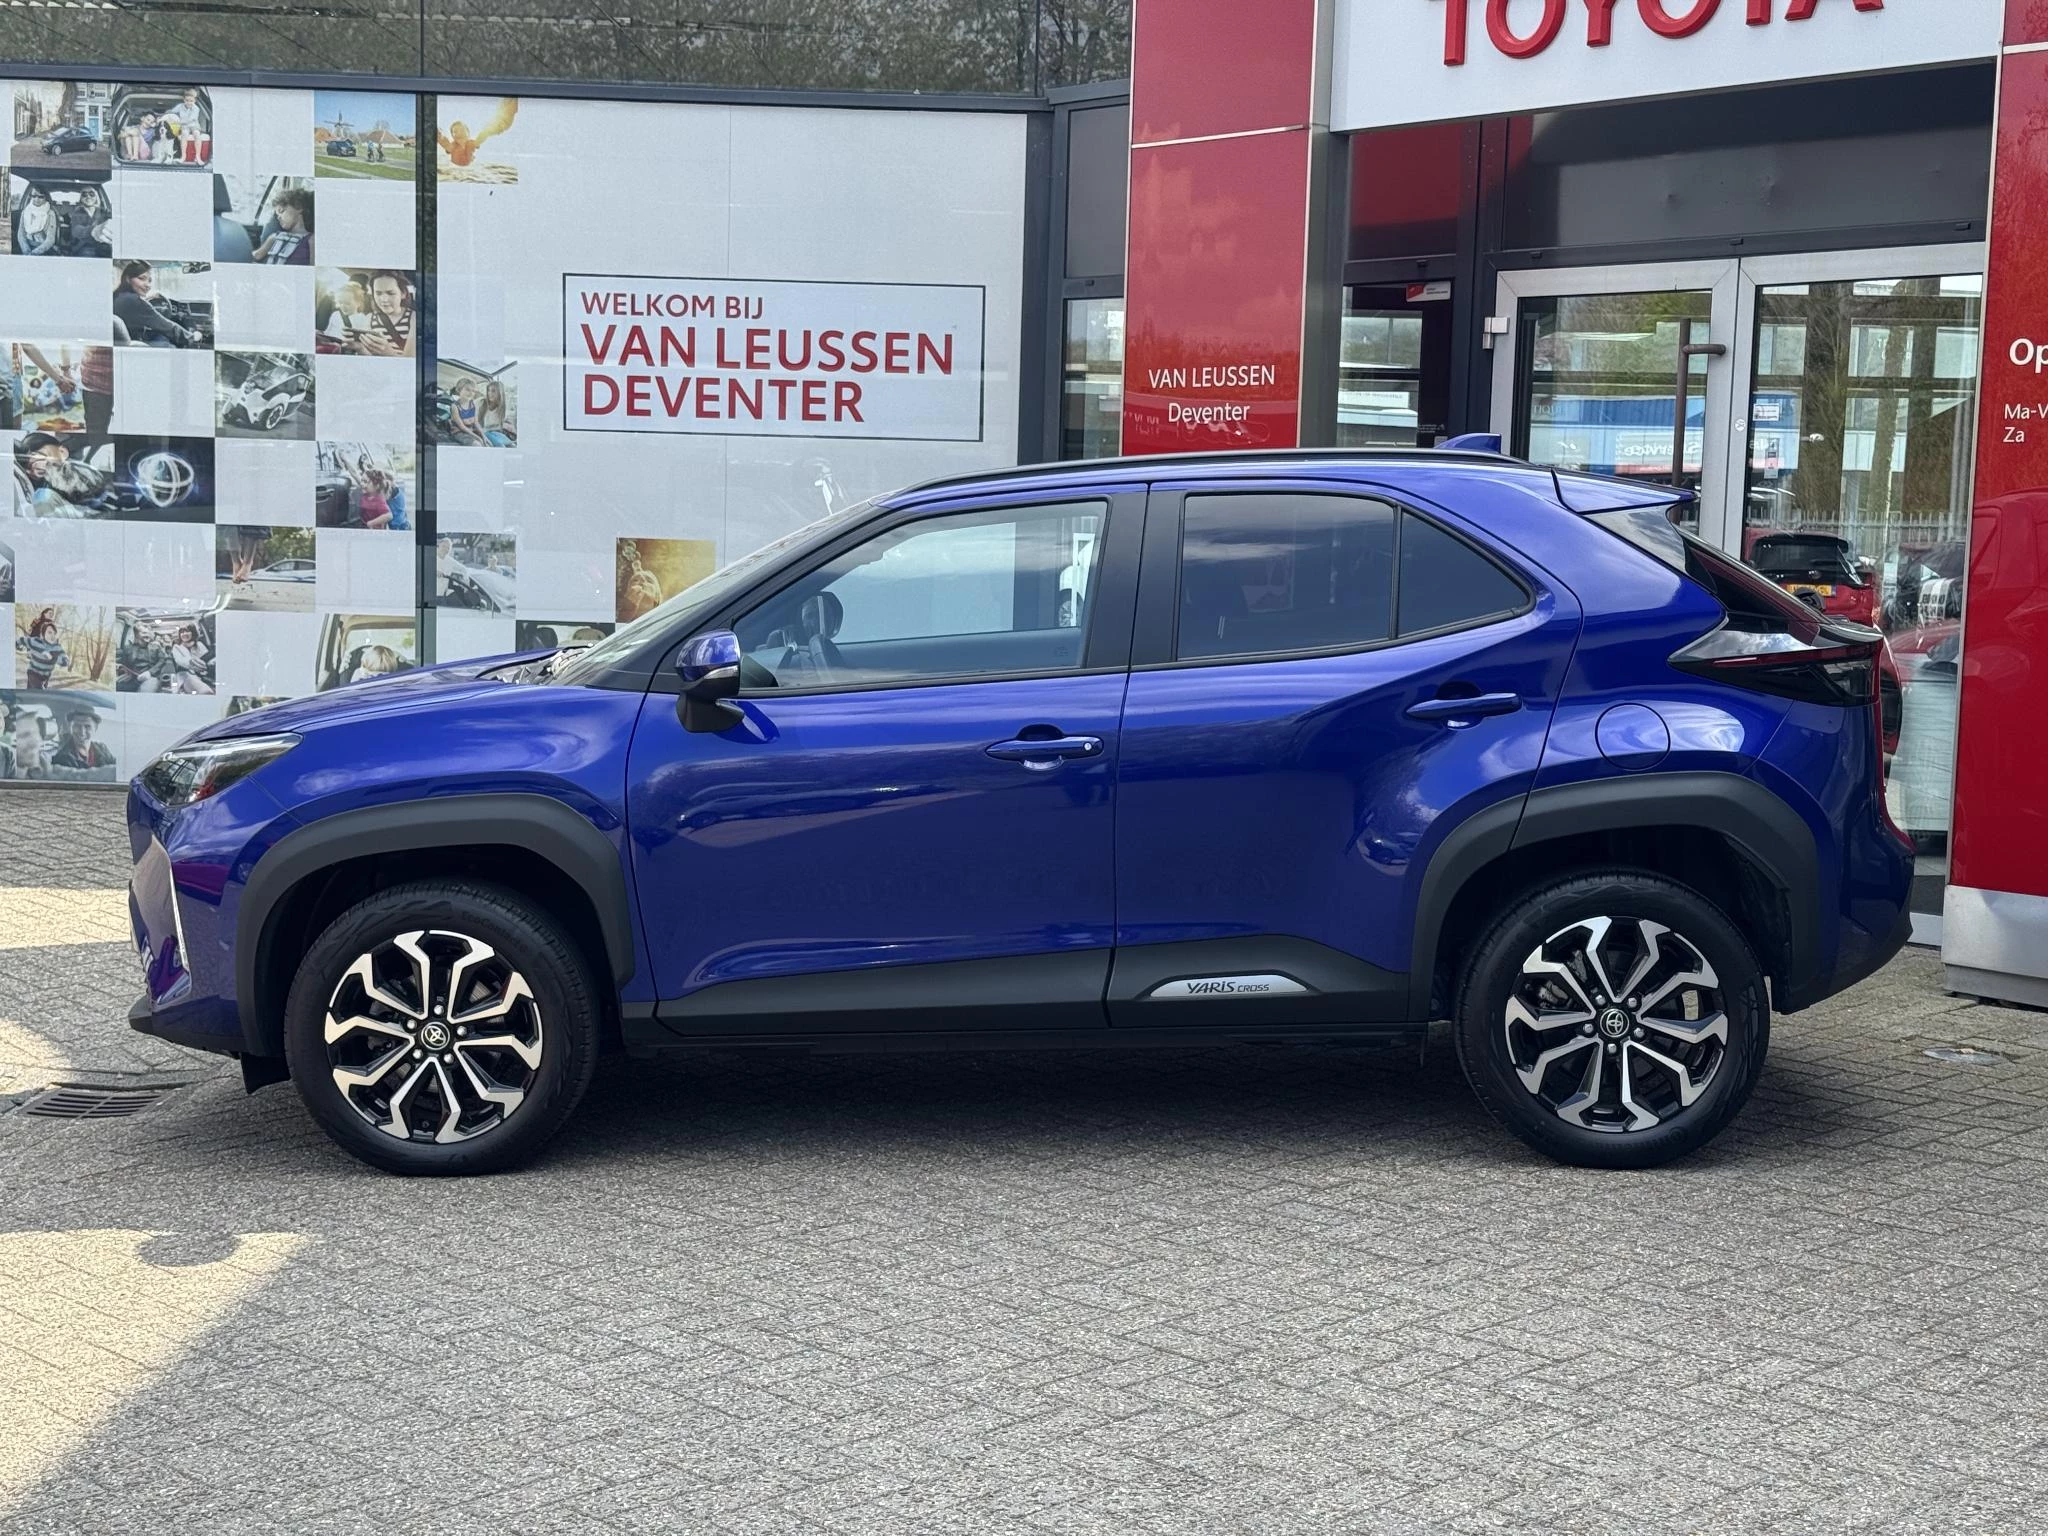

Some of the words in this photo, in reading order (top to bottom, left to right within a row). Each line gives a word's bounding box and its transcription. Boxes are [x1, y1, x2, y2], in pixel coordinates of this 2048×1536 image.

[581, 291, 715, 318] WELKOM
[725, 296, 763, 319] BIJ
[581, 323, 696, 368] VAN
[716, 327, 953, 375] LEUSSEN
[2009, 338, 2048, 374] Op
[1148, 368, 1187, 389] VAN
[1192, 365, 1275, 387] LEUSSEN
[583, 374, 865, 422] DEVENTER
[1168, 402, 1250, 422] Deventer
[2003, 426, 2025, 443] Za
[1237, 984, 1270, 993] CROSS
